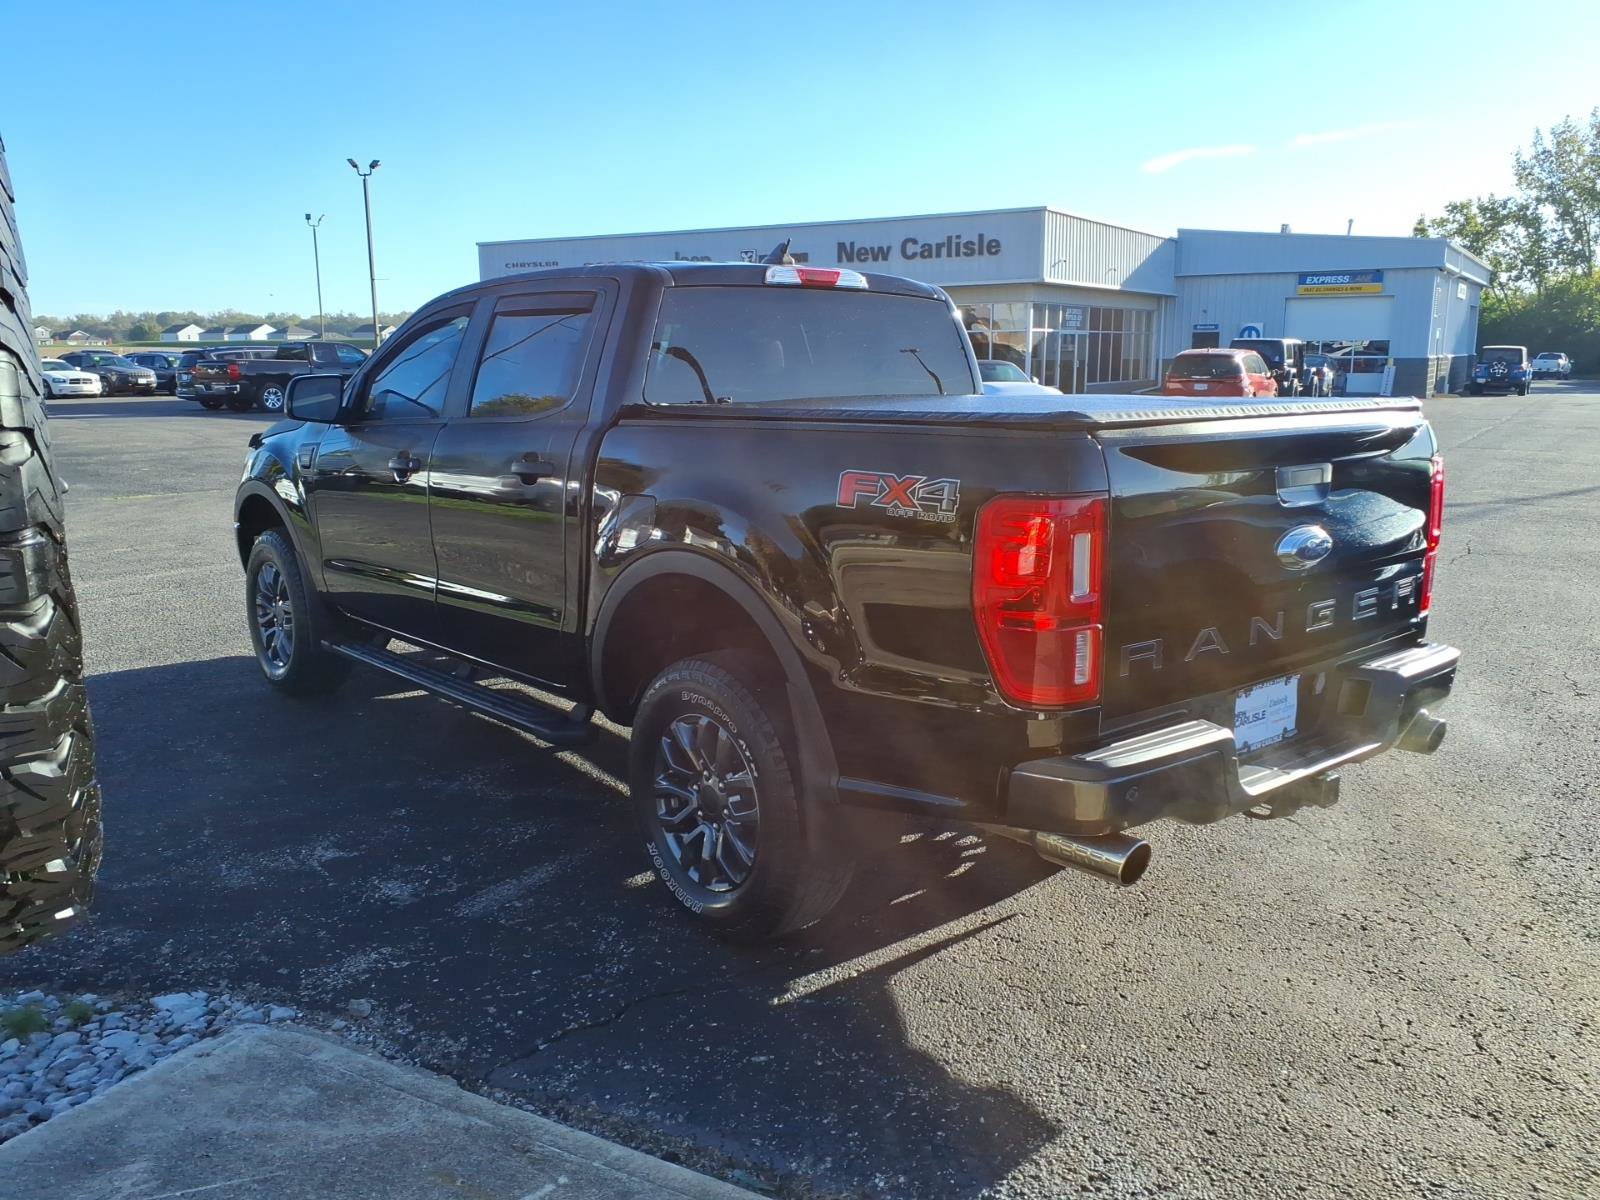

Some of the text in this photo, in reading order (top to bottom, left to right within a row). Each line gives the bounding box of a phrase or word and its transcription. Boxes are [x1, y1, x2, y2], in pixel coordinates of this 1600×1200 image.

[837, 241, 892, 263] New
[900, 233, 1002, 260] Carlisle
[504, 261, 559, 269] CHRYSLER
[1306, 275, 1350, 284] EXPRESS
[836, 469, 961, 515] FX4
[1119, 575, 1418, 678] RANGER
